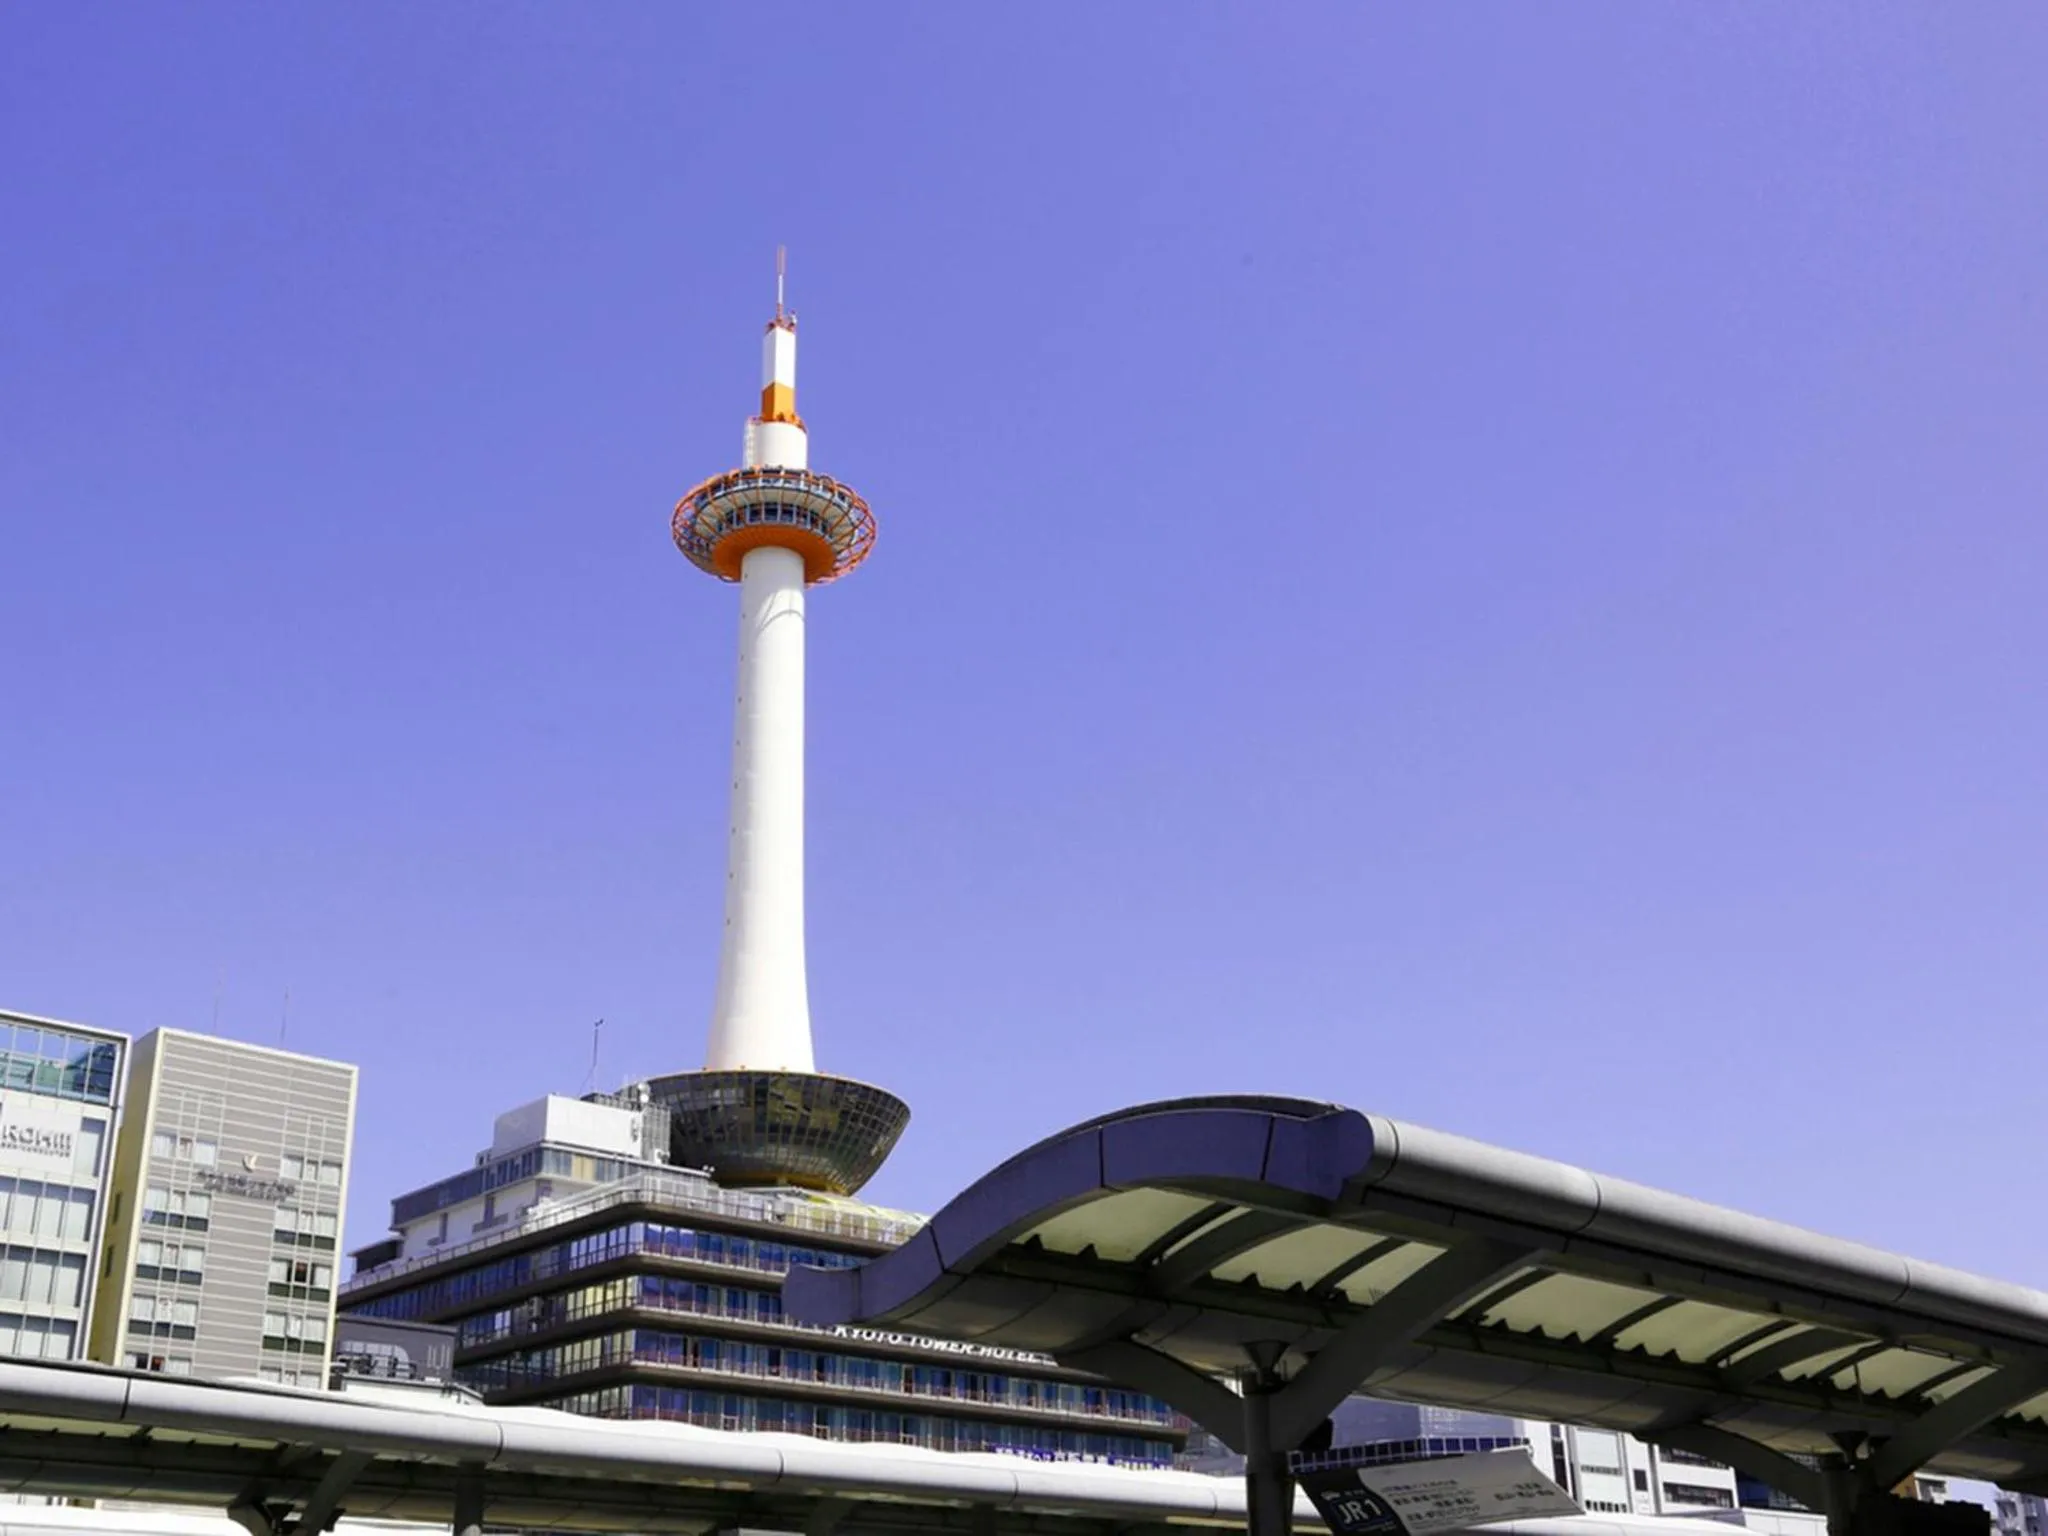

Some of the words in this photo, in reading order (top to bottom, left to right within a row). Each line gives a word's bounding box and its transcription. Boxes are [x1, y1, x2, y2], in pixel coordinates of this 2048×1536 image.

[833, 1325, 901, 1344] KYOTO
[908, 1333, 974, 1355] TOWER
[979, 1345, 1037, 1363] HOTEL
